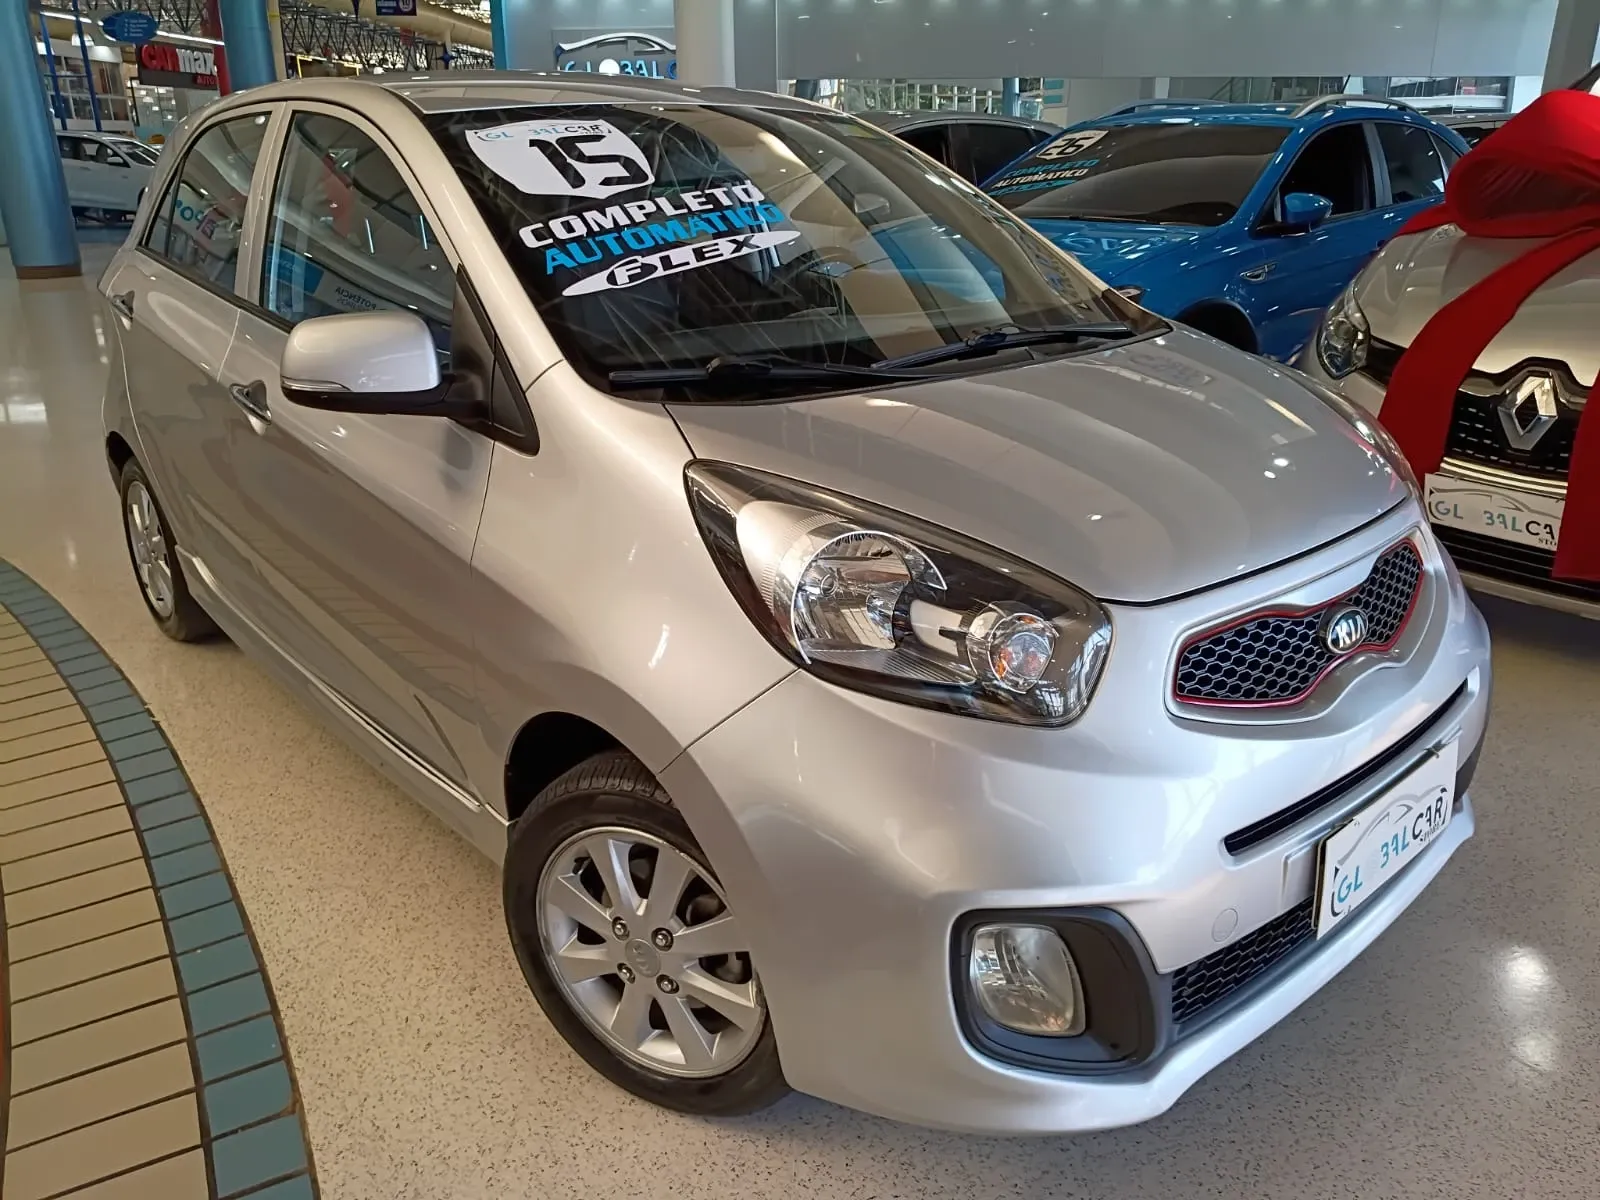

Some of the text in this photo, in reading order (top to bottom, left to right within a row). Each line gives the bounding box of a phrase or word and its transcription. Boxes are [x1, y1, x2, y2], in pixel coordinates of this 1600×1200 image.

[528, 134, 650, 190] 15
[518, 180, 766, 249] COMPLETO
[606, 234, 762, 288] FLEX
[1335, 614, 1366, 648] KIA
